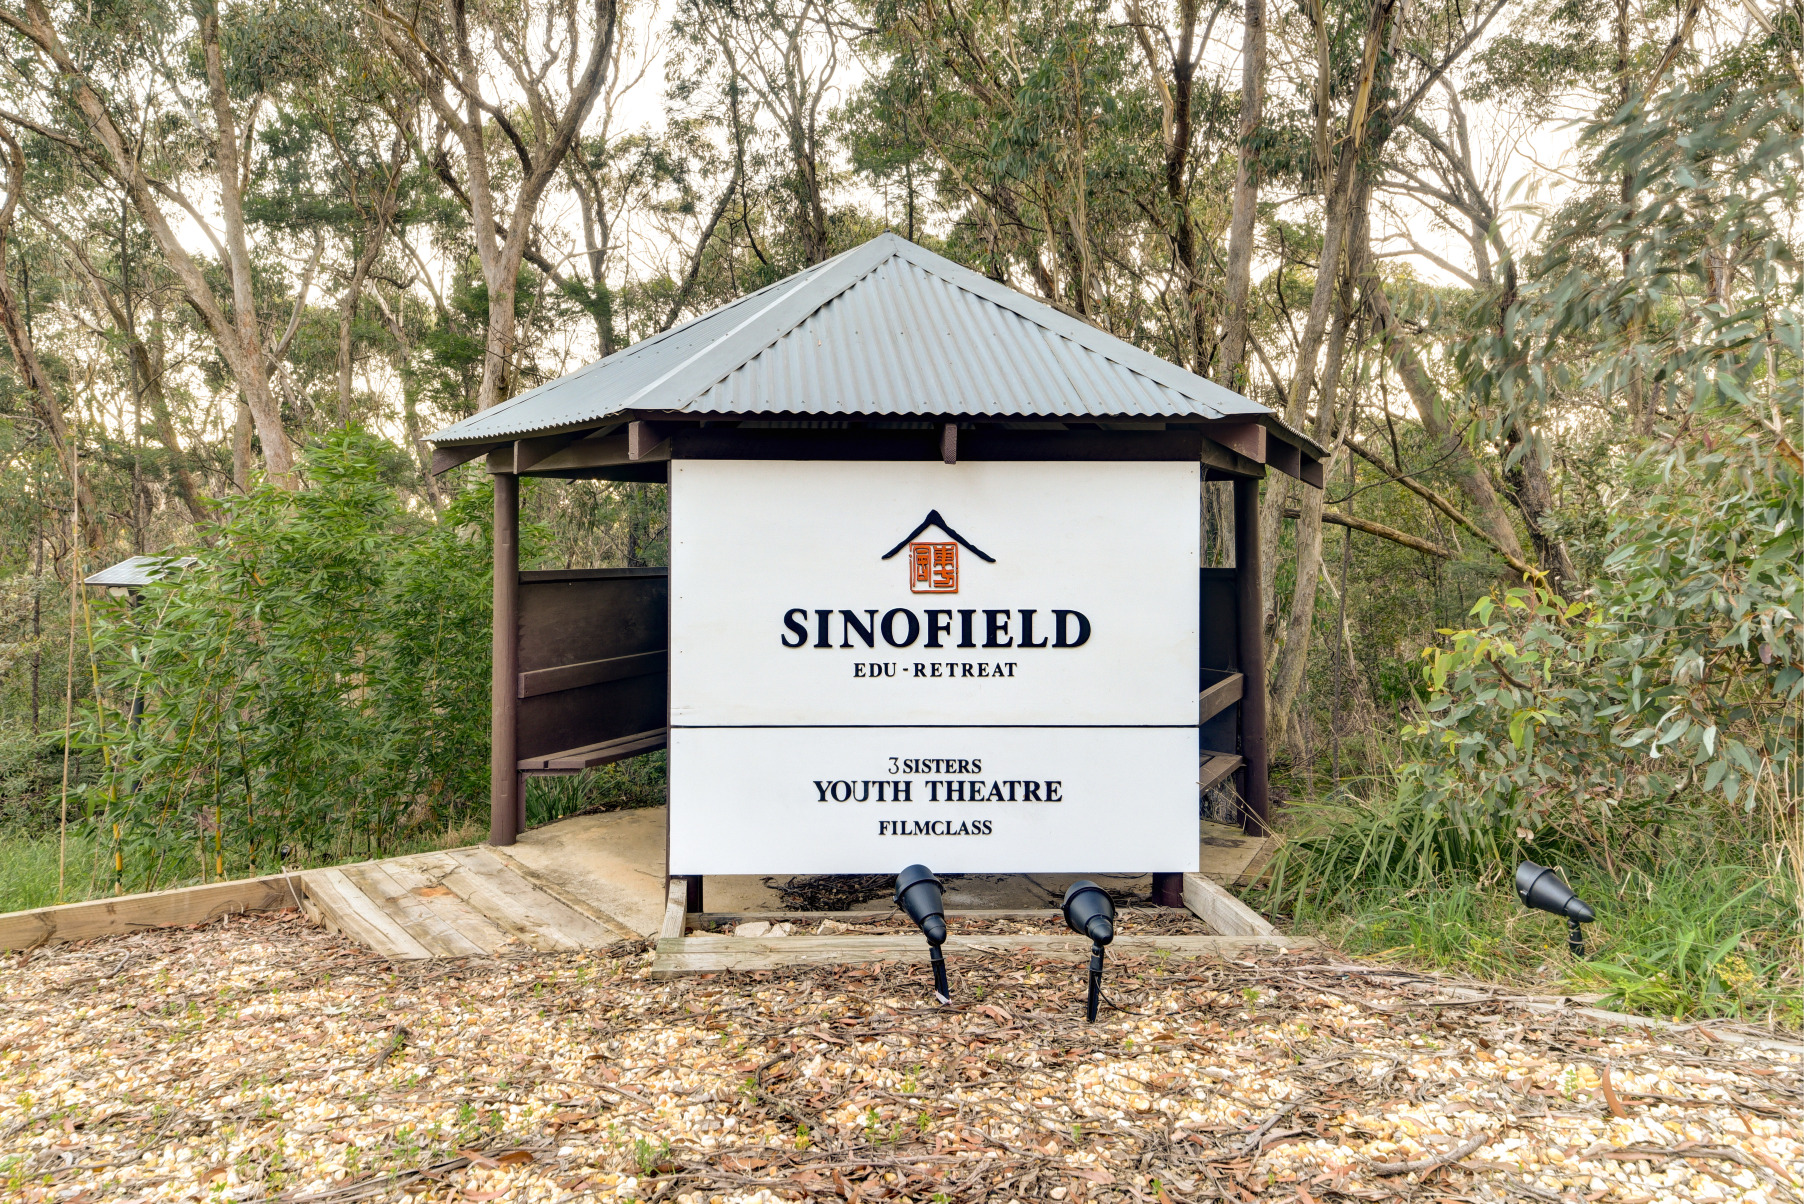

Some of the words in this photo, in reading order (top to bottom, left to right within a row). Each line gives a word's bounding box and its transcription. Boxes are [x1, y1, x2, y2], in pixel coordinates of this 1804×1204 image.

[780, 607, 1092, 649] SINOFIELD
[888, 756, 900, 775] 3
[902, 758, 982, 774] SISTERS
[812, 780, 913, 803] YOUTH
[924, 780, 1063, 803] THEATRE
[878, 819, 993, 836] FILMCLASS
